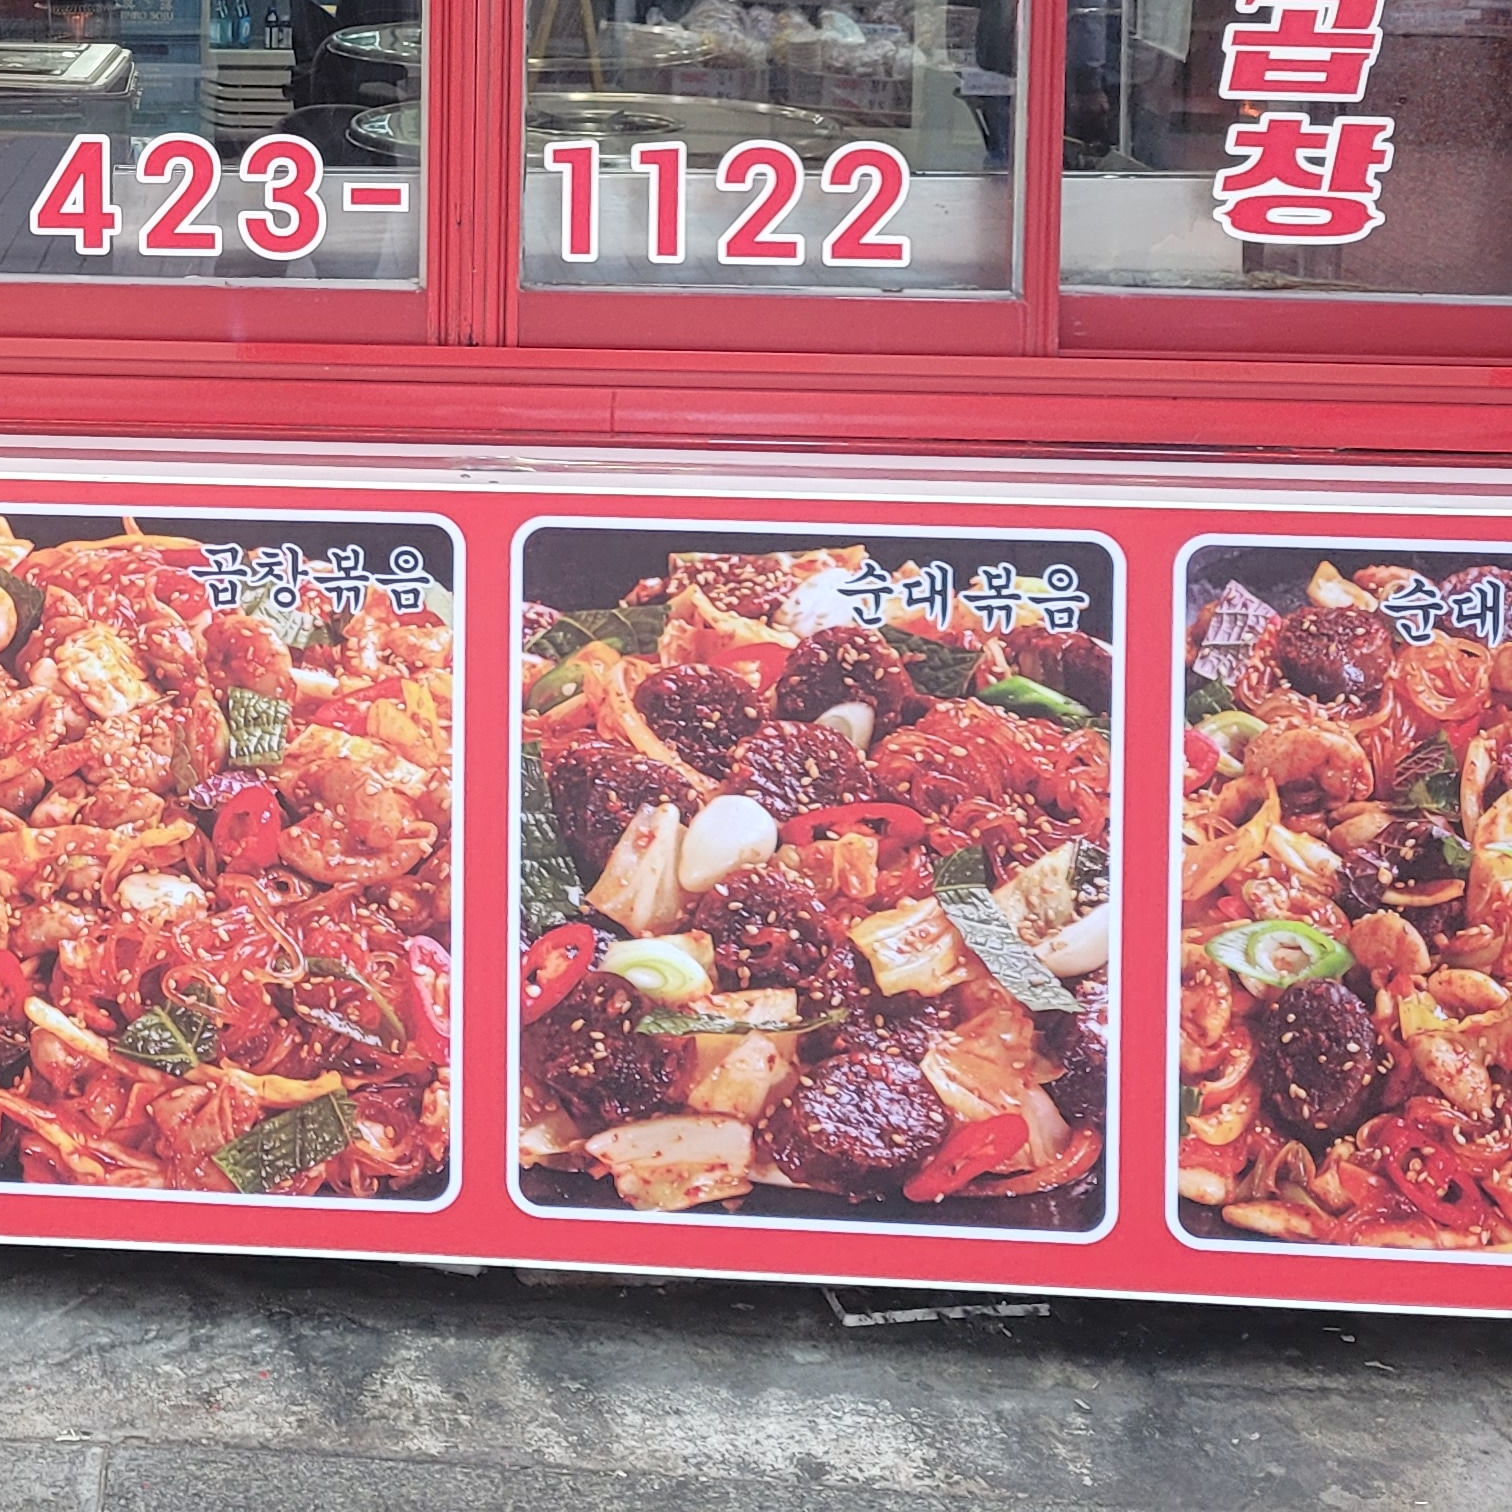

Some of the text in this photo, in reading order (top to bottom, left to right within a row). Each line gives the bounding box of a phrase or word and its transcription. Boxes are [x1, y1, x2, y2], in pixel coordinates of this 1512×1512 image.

[29, 133, 911, 268] 423- 1122
[189, 541, 433, 615] 곱창볶음
[836, 559, 1088, 635] 순대볶음
